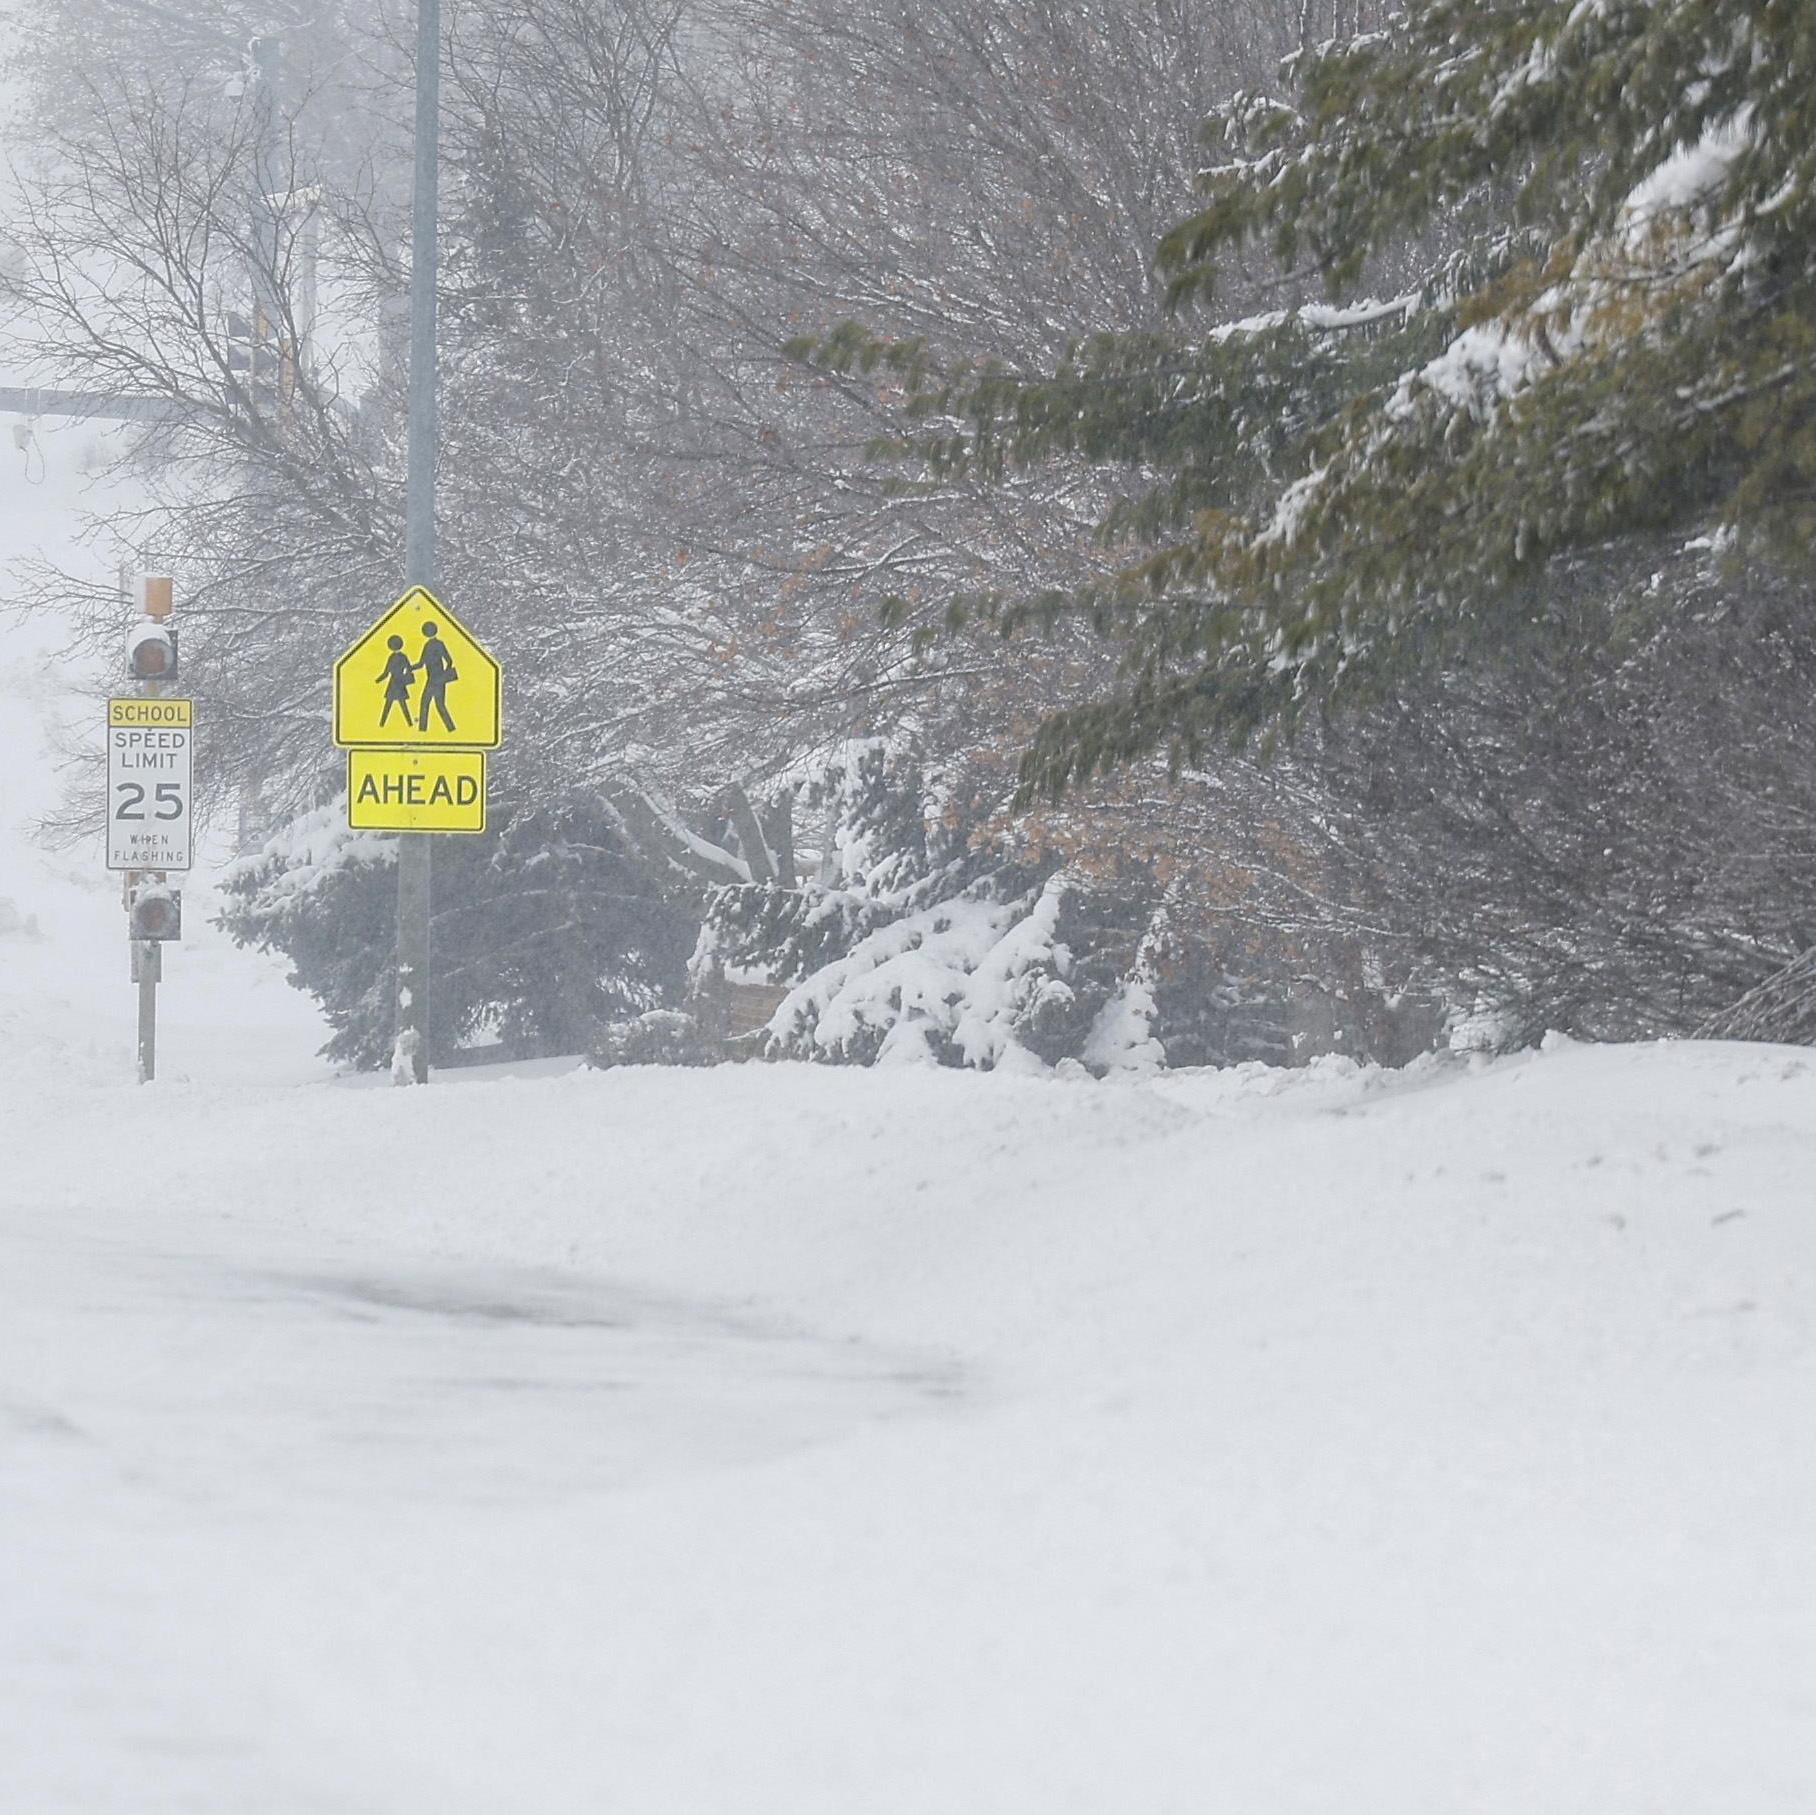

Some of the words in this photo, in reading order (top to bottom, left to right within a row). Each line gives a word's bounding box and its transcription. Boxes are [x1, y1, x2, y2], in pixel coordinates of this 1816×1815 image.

[113, 705, 187, 722] SCHOOL
[115, 732, 185, 748] SPEED
[122, 753, 177, 769] LIMIT
[357, 776, 479, 806] AHEAD
[116, 782, 183, 820] 25
[130, 834, 169, 845] WHEN
[114, 850, 184, 862] FLASHING
